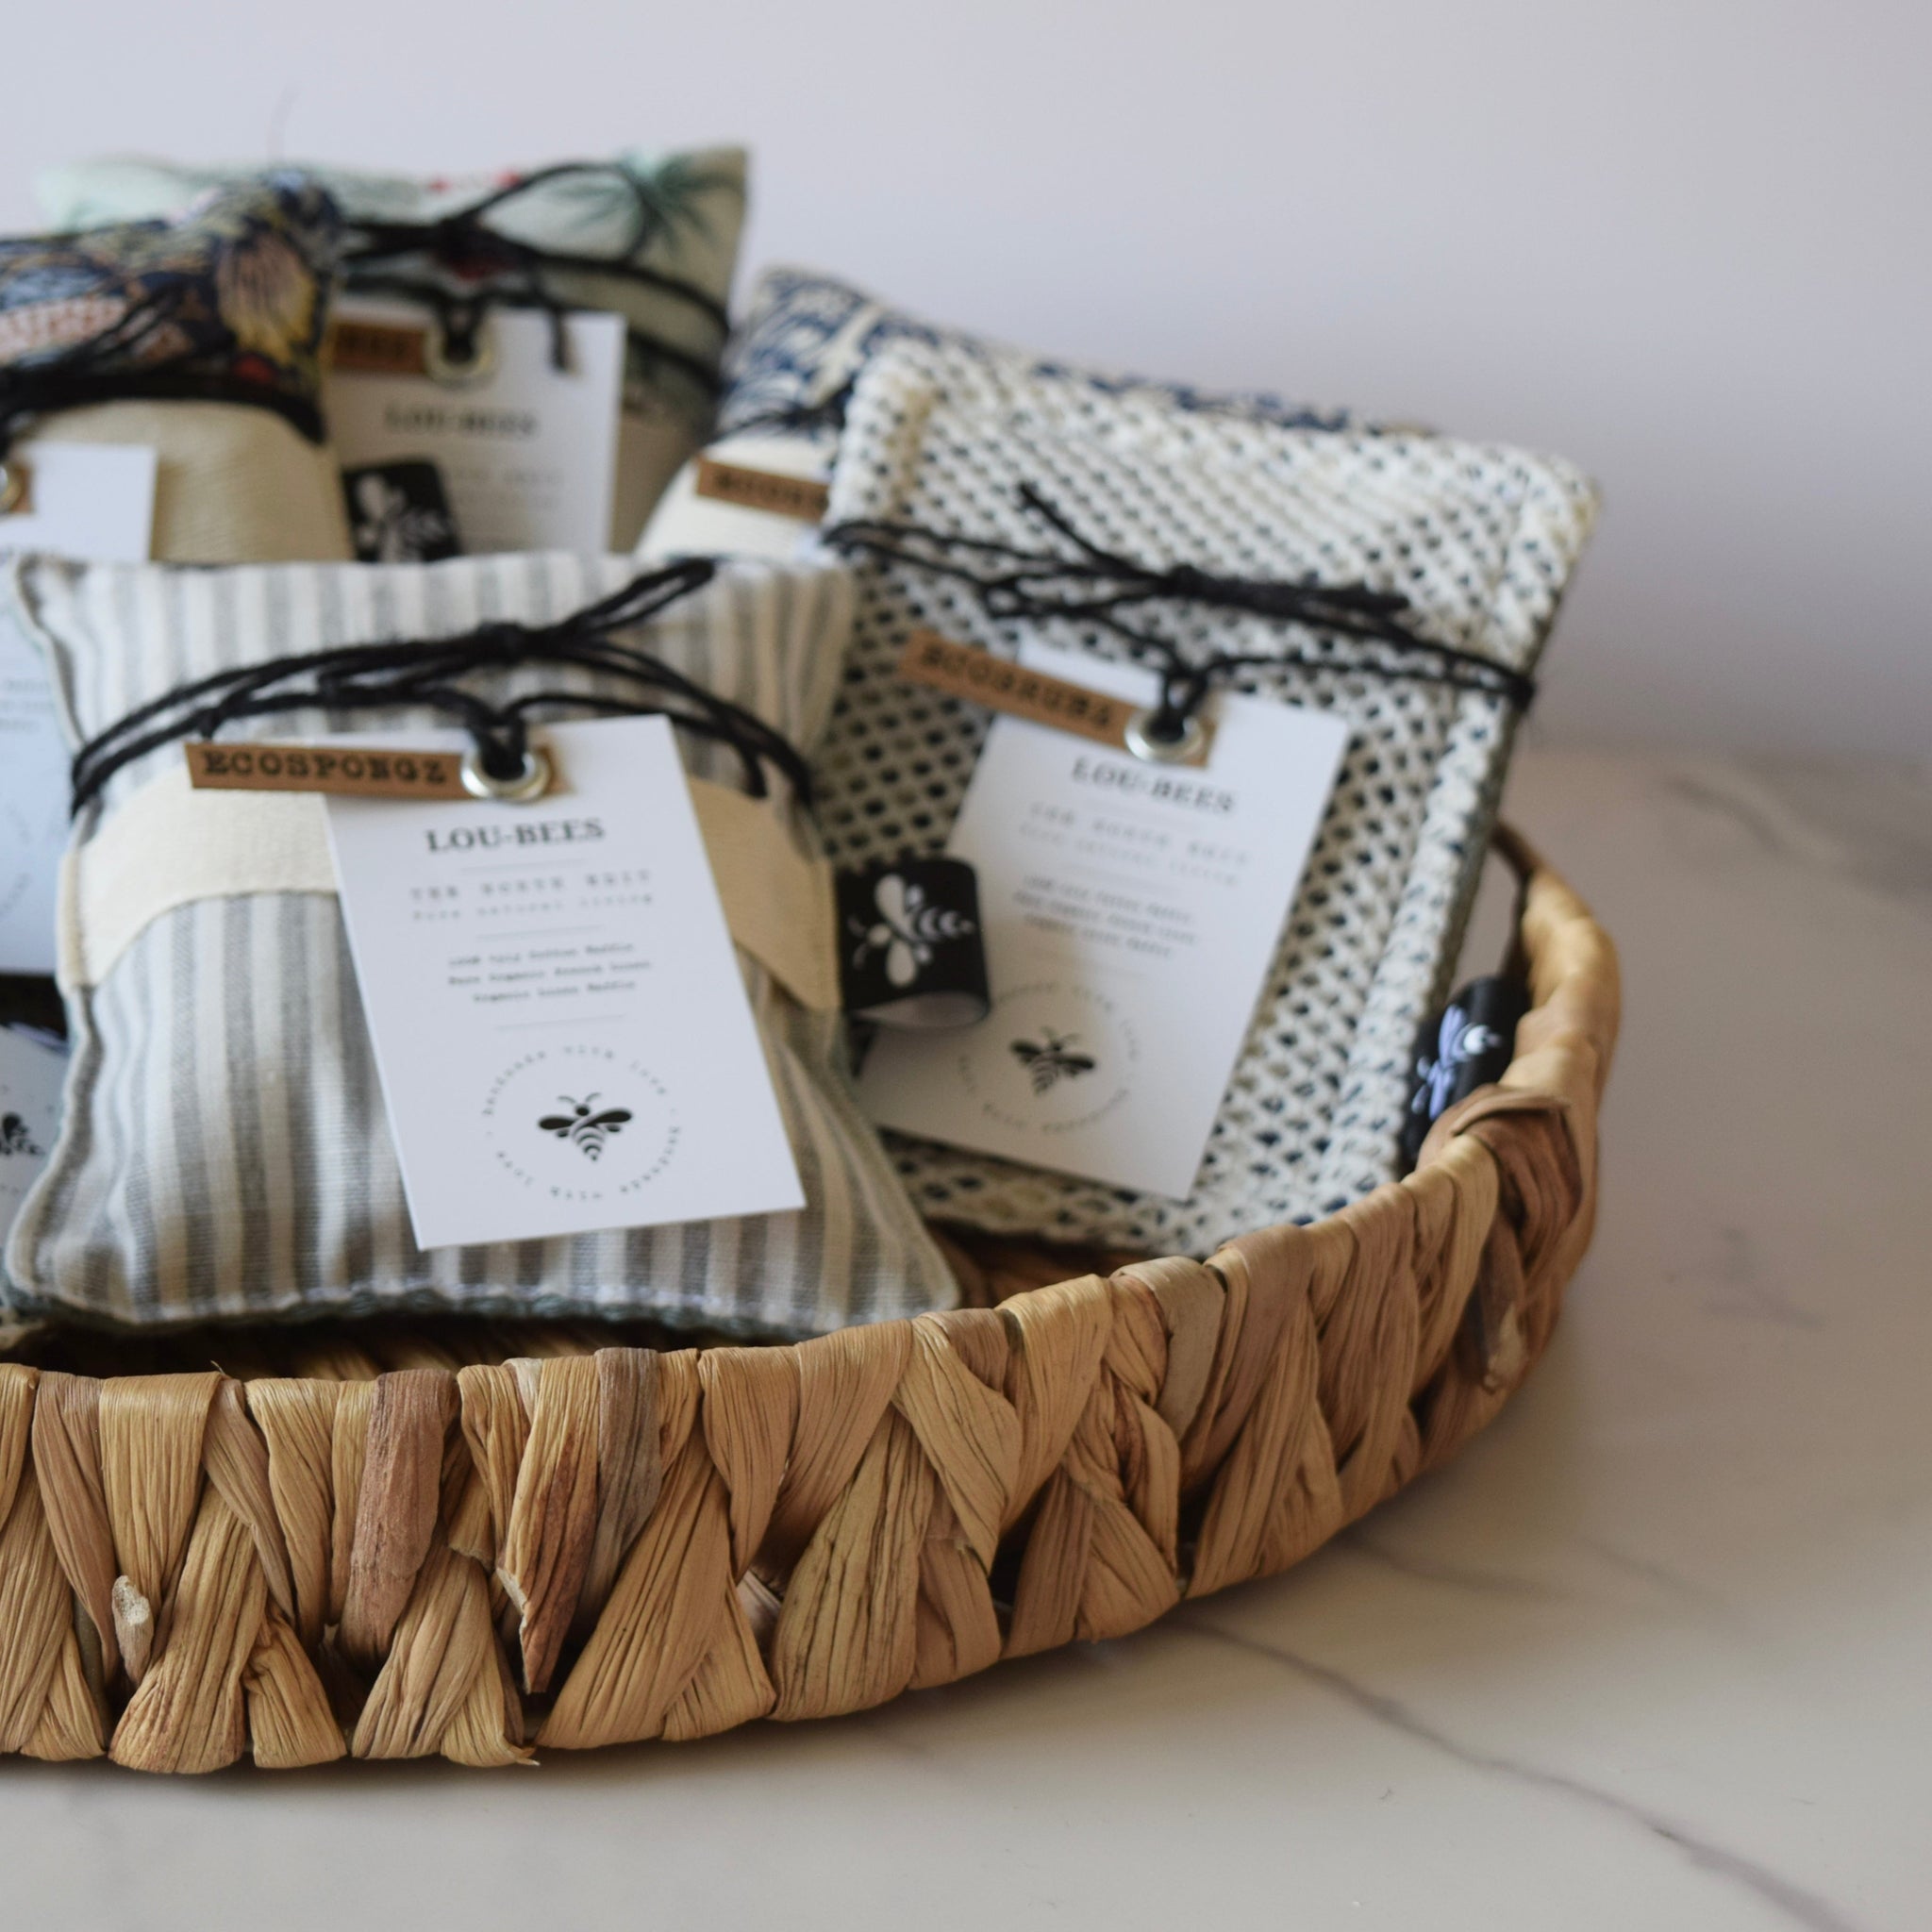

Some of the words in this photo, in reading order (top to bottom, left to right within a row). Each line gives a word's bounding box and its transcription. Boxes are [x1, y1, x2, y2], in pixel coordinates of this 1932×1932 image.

[203, 750, 448, 786] ECOSPONGZ
[1072, 757, 1236, 813] LOU-BEES
[425, 818, 605, 853] LOU-BEES
